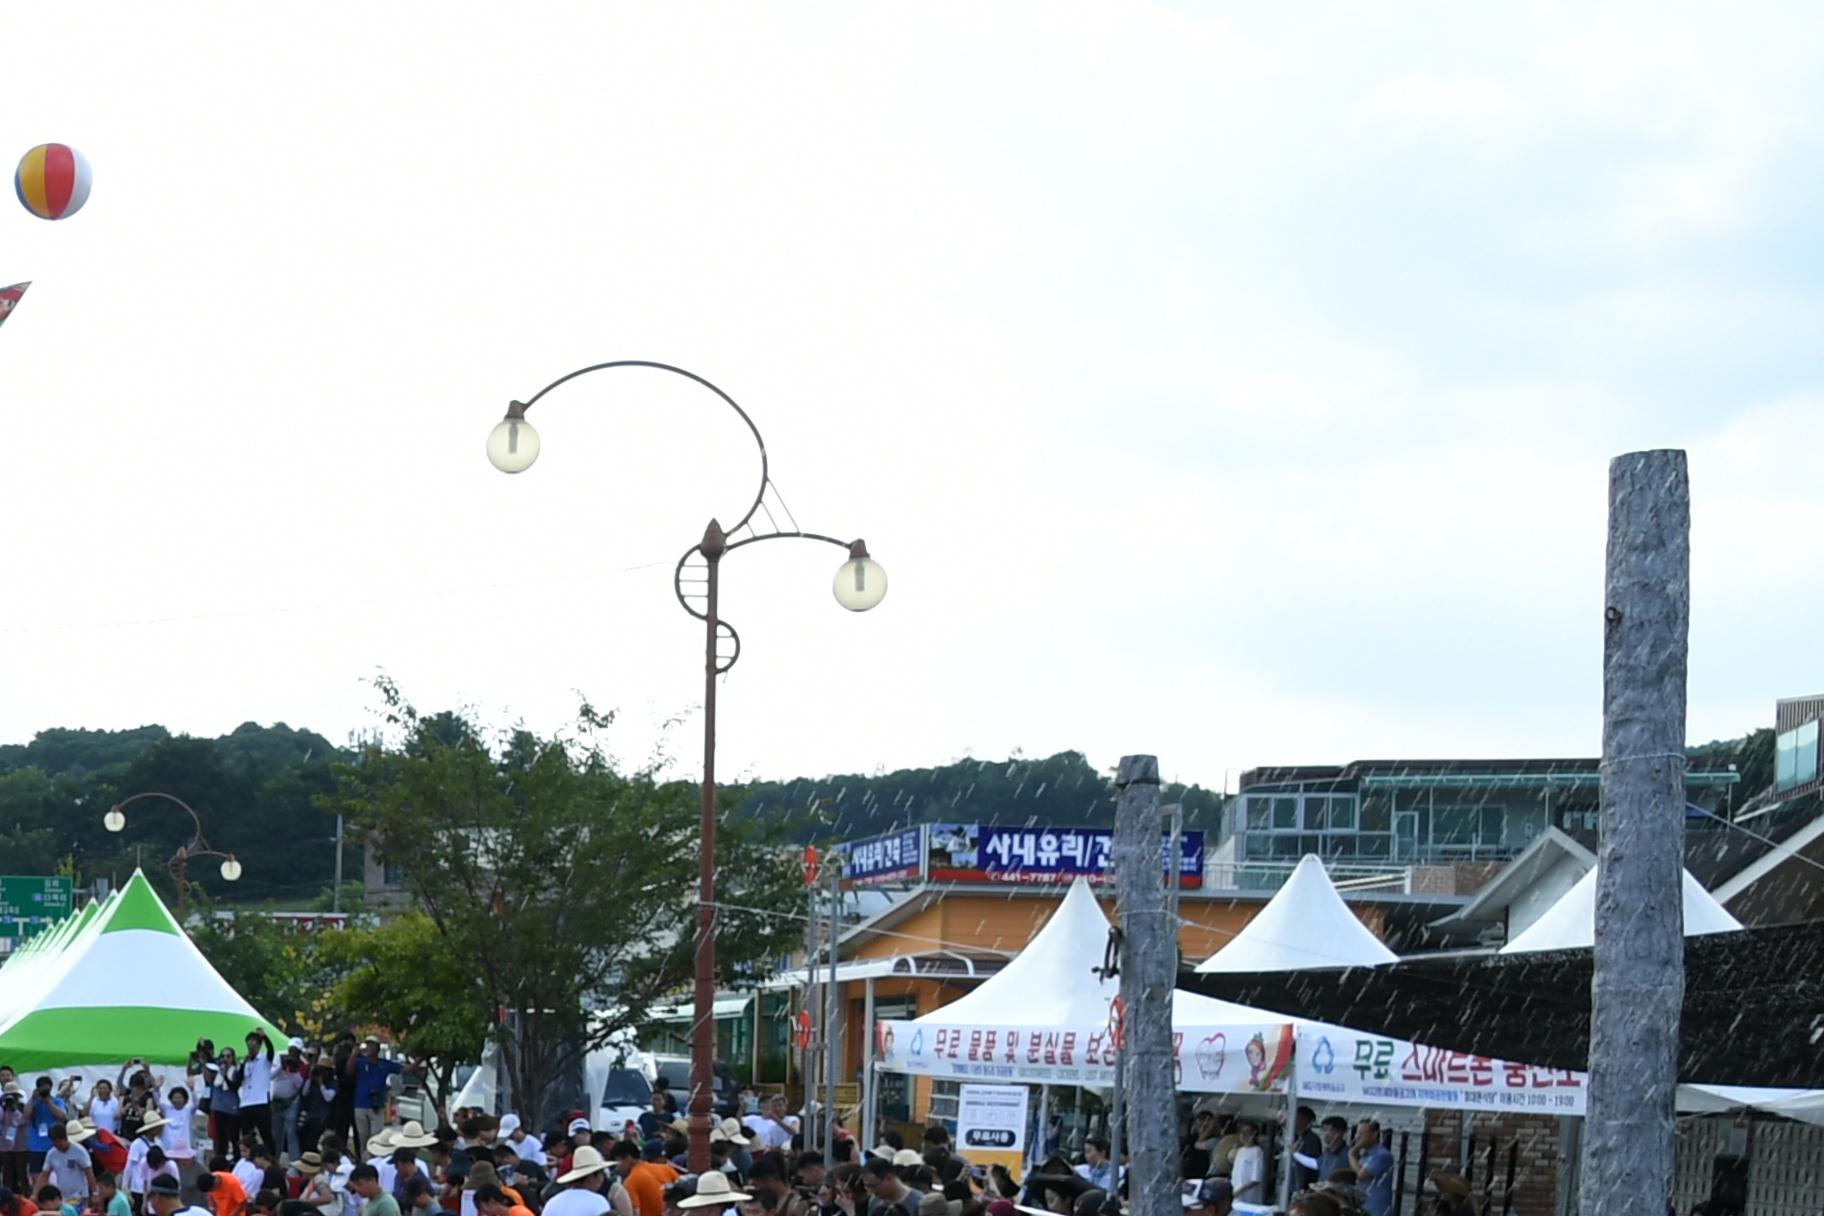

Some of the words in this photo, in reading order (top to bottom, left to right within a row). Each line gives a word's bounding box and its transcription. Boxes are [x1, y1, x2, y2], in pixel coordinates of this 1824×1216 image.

[934, 1029, 960, 1059] 무료
[968, 1030, 996, 1062] 물품
[1005, 1031, 1019, 1063] 및
[1027, 1032, 1076, 1065] 분실물
[1353, 1039, 1395, 1080] 무료
[1401, 1043, 1493, 1086] 스마트폰
